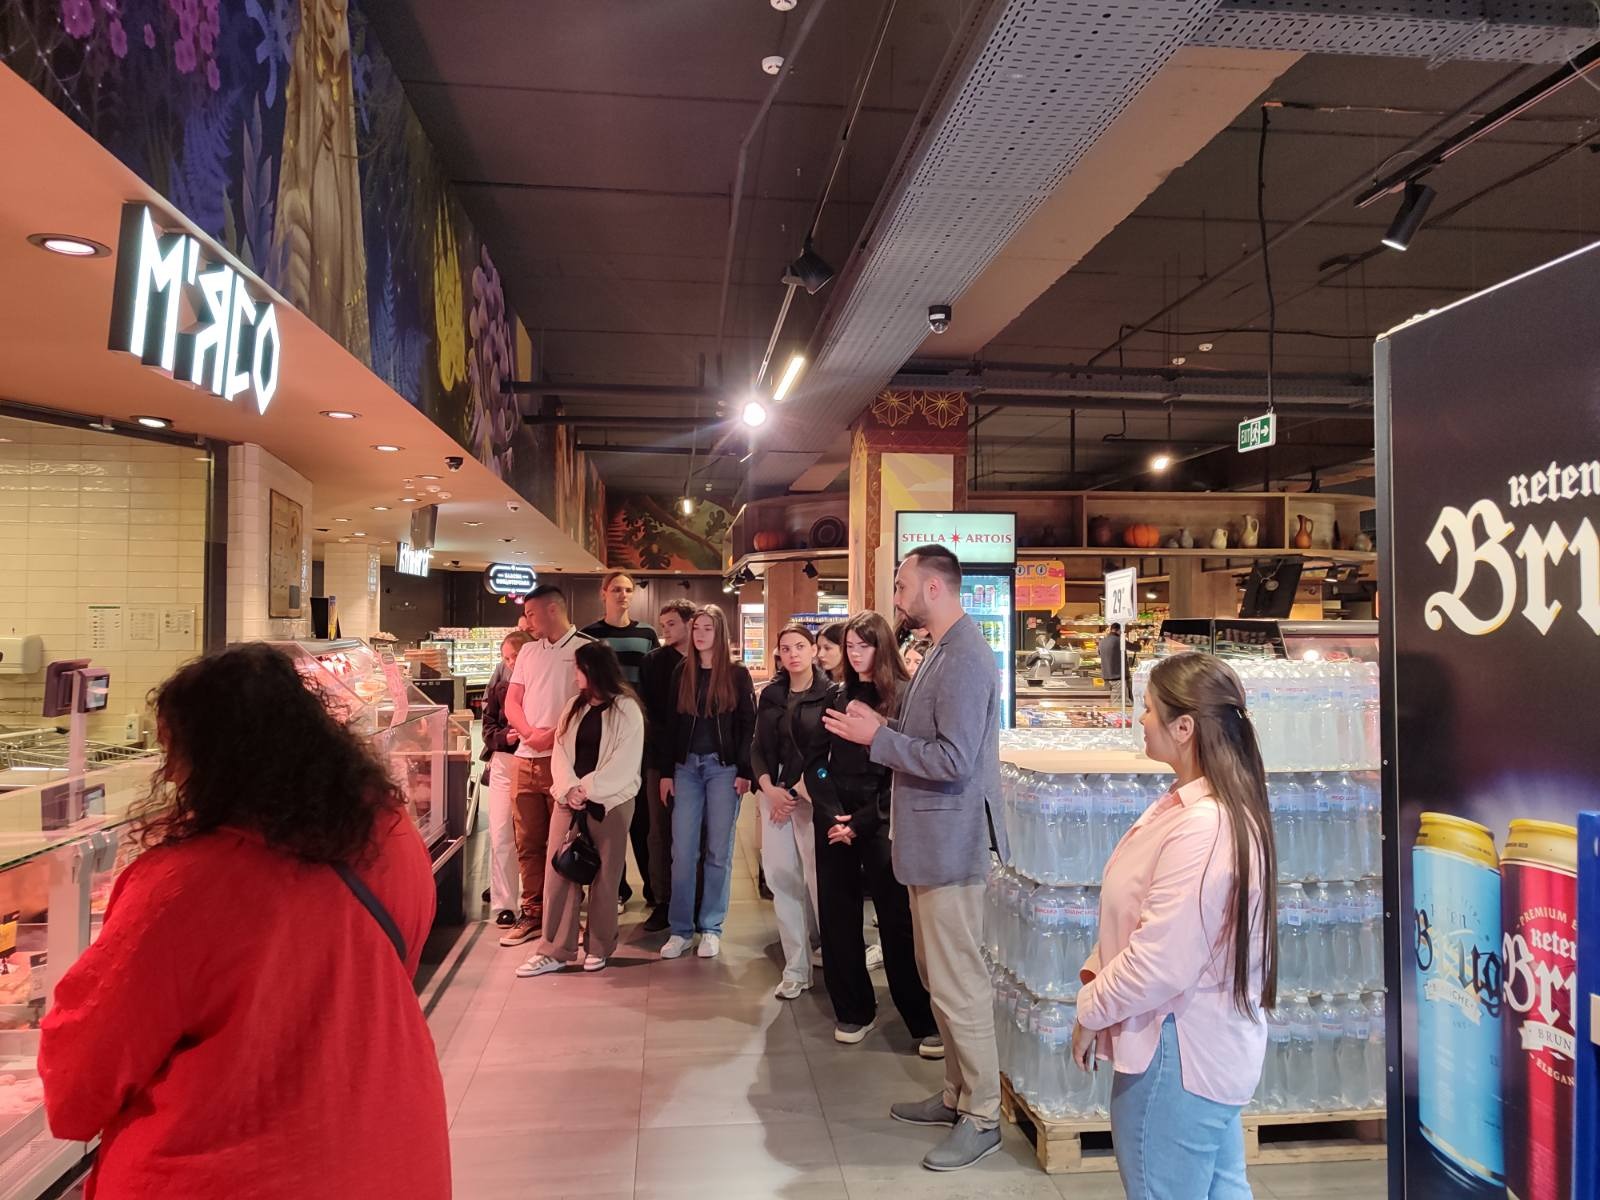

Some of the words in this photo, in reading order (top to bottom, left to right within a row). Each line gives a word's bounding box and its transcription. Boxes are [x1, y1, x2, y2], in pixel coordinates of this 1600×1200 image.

[1241, 428, 1250, 444] EXIT
[902, 533, 946, 543] STELLA
[965, 533, 1012, 544] ARTOIS
[1519, 906, 1568, 927] PREMIUM
